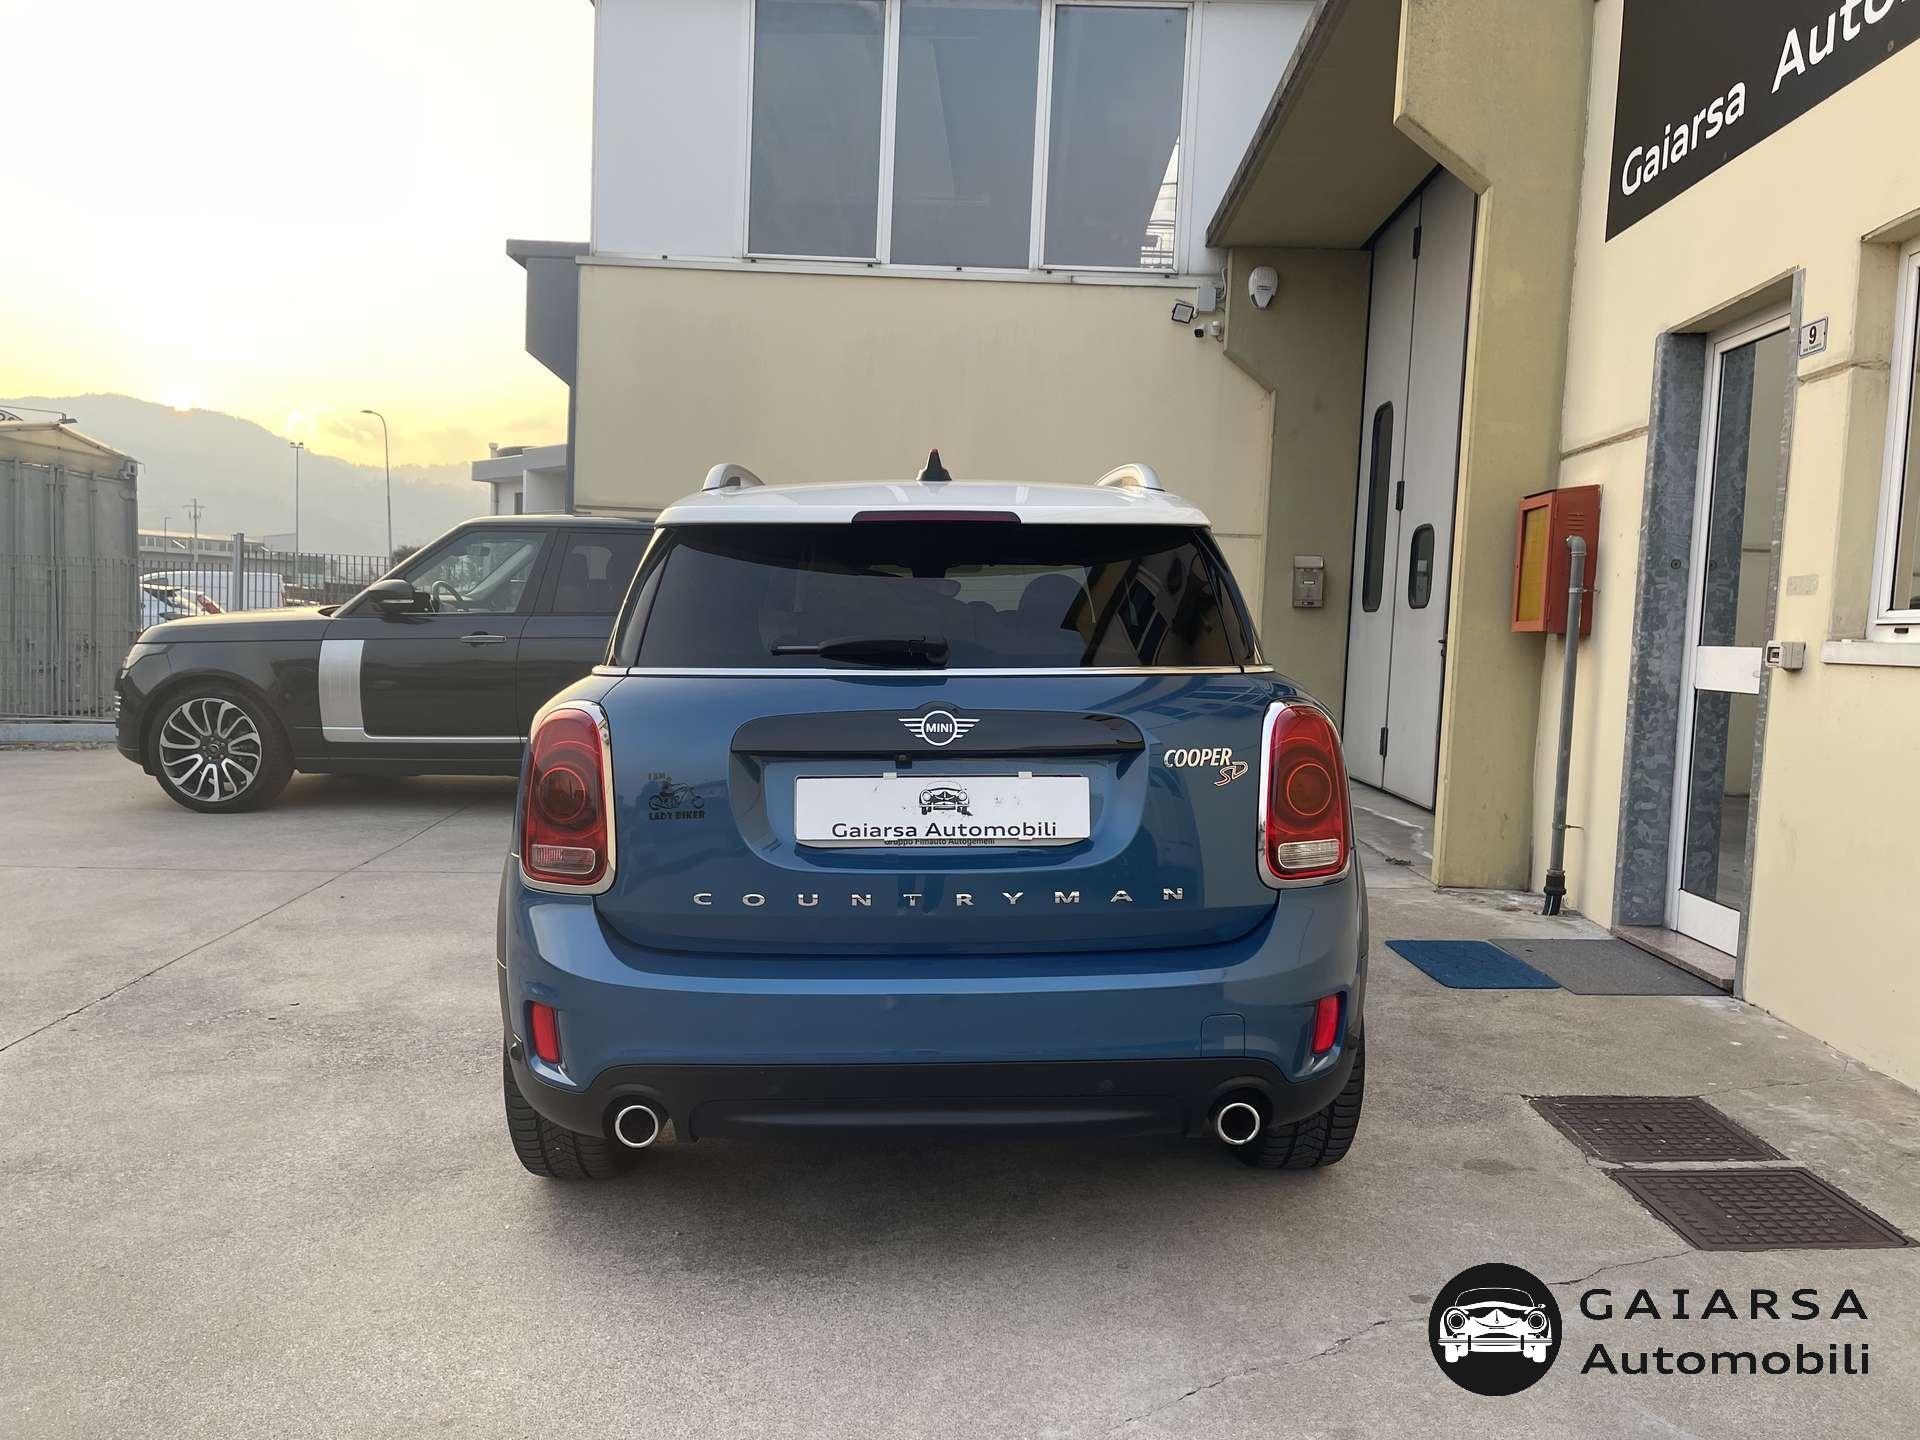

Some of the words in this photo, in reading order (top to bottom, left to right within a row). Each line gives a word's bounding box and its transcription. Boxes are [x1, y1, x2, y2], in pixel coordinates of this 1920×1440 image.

[1621, 81, 1746, 197] Gaiarsa
[1771, 0, 1906, 94] Auto
[1809, 325, 1817, 344] 9
[926, 722, 953, 733] MINI
[1163, 747, 1233, 768] COOPER
[1213, 761, 1249, 786] SD
[831, 822, 917, 838] Gaiarsa
[925, 822, 1057, 838] Automobili
[693, 887, 1185, 907] COUNTRYMAN
